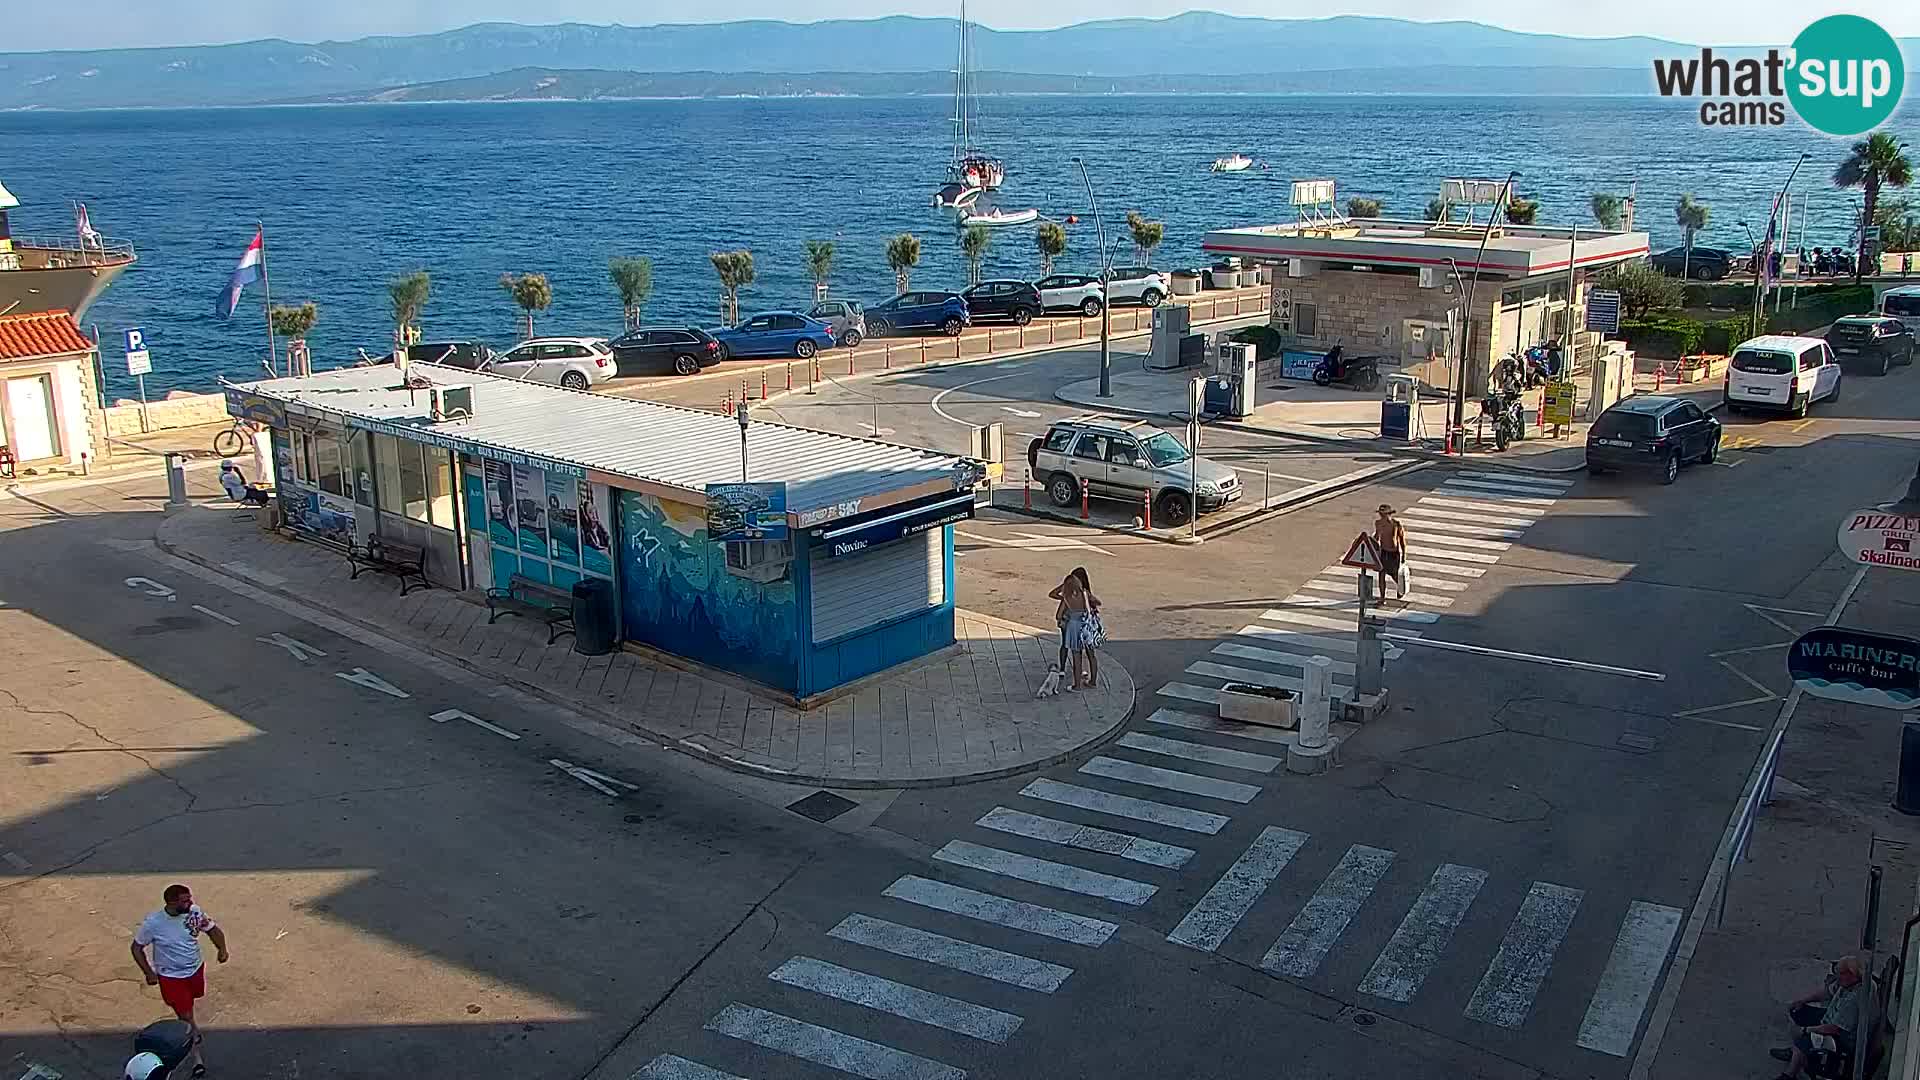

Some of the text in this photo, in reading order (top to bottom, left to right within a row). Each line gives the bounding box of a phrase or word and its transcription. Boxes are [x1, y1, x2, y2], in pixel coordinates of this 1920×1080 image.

[128, 331, 142, 350] P
[478, 446, 492, 457] BUS
[493, 450, 526, 464] STATION
[528, 458, 554, 471] TICKET
[555, 464, 582, 476] OFFICE
[1848, 514, 1920, 533] PIZZE
[1828, 661, 1898, 680] caffe bar
